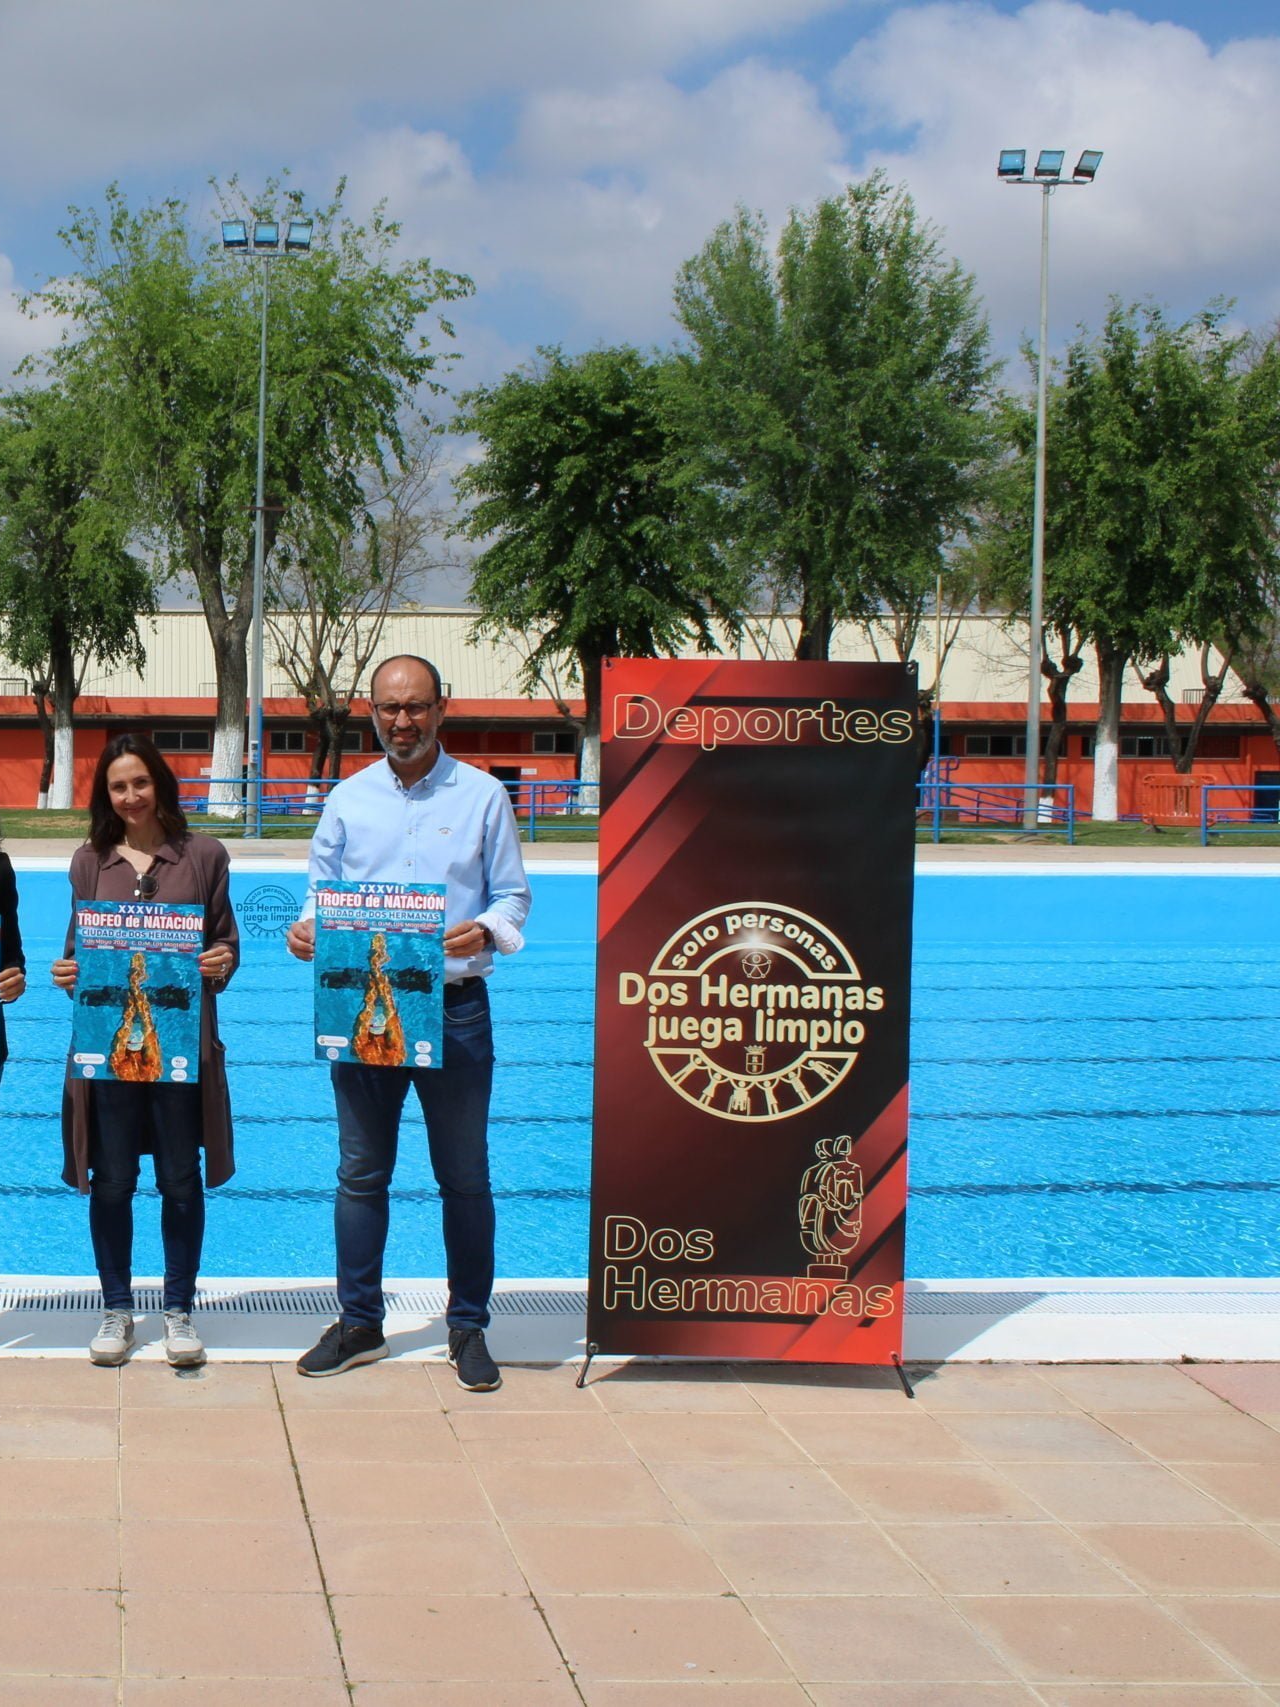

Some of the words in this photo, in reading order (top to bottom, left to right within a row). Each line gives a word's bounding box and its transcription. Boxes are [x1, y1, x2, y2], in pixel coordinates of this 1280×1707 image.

[613, 693, 914, 751] Deportes
[358, 884, 404, 894] XXXVII
[119, 905, 164, 914] XXXVII
[236, 903, 254, 912] Dos
[317, 892, 362, 907] TROFEO
[365, 895, 380, 907] de
[383, 893, 444, 910] NATACIÓN
[78, 913, 122, 927] TROFEO
[125, 915, 140, 928] de
[144, 914, 203, 930] NATACIÓN
[243, 911, 268, 923] juega
[271, 912, 299, 922] limpio
[321, 909, 354, 918] CIUDAD
[369, 911, 387, 919] DOS
[389, 912, 439, 920] HERMANAS
[81, 929, 114, 937] CIUDAD
[149, 932, 198, 940] HERMANAS
[671, 923, 720, 970] solo
[725, 913, 838, 972] personas
[619, 972, 688, 1006] Dos
[700, 973, 884, 1011] Hermanas
[643, 1004, 743, 1049] juega
[755, 1008, 865, 1051] limpio
[604, 1215, 714, 1262] Dos
[603, 1265, 895, 1317] Hermanas
